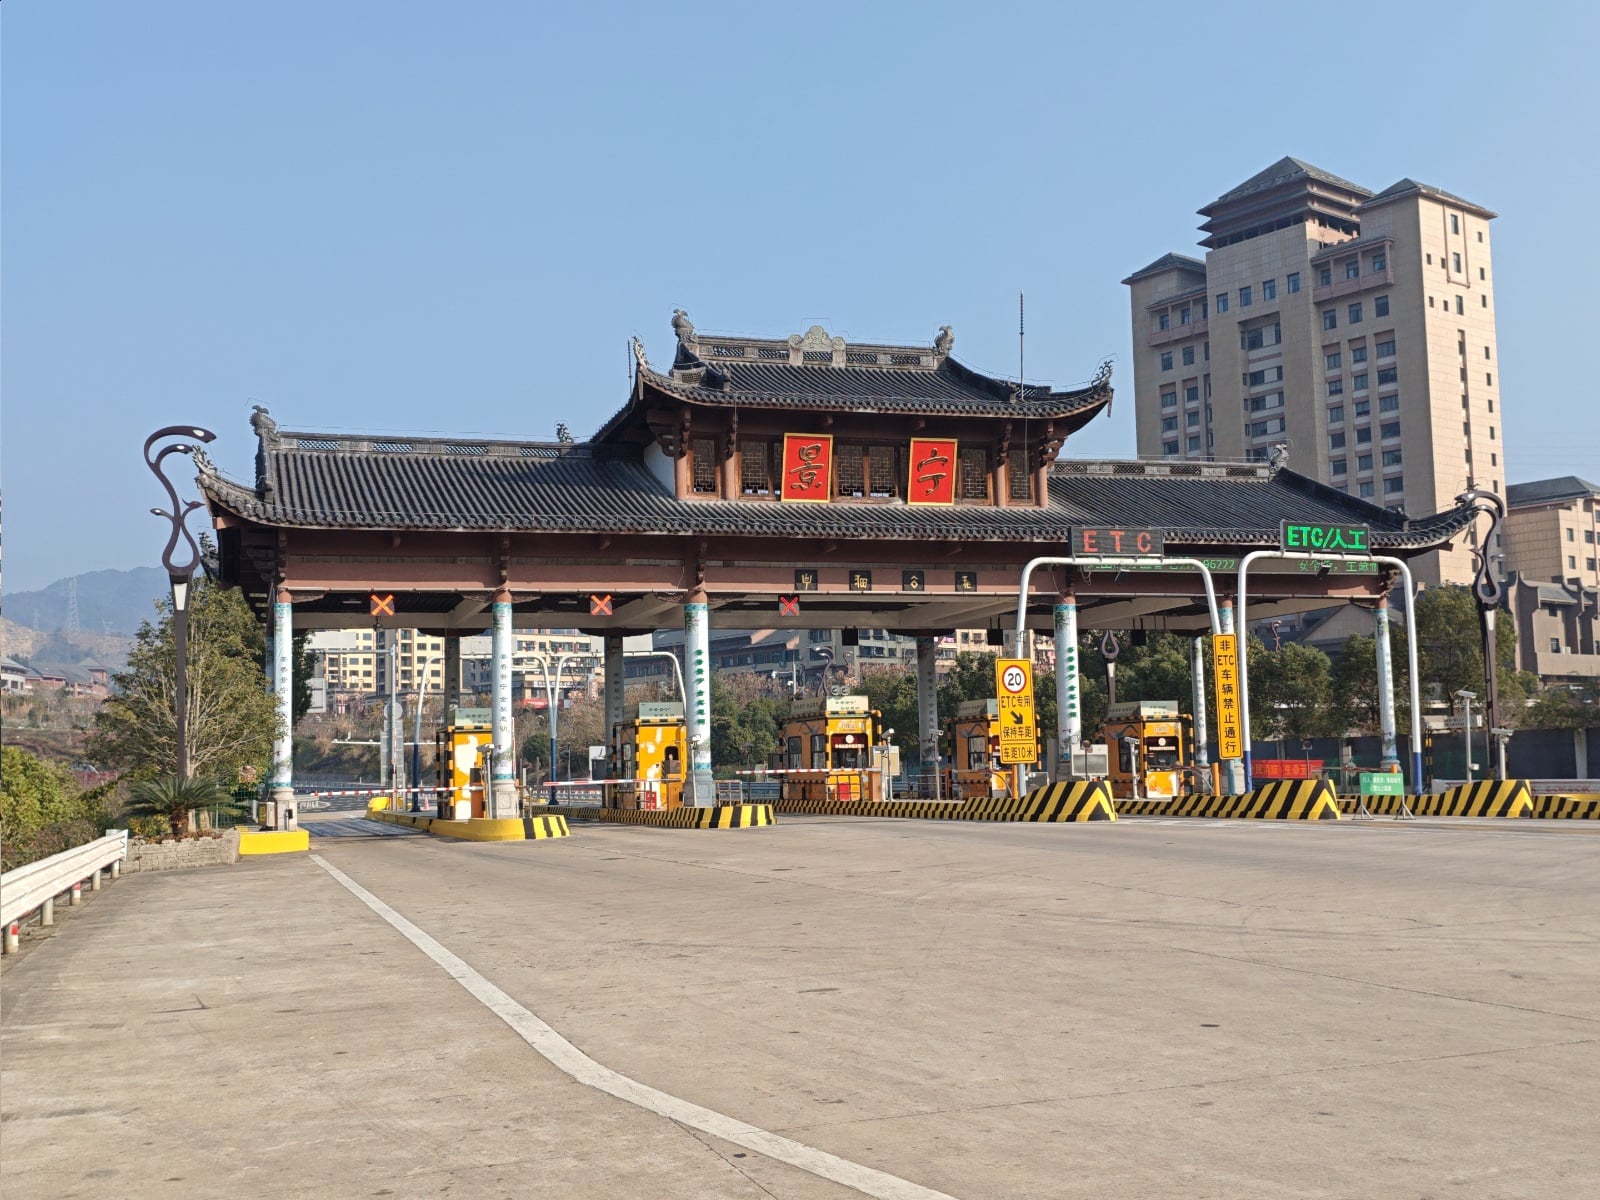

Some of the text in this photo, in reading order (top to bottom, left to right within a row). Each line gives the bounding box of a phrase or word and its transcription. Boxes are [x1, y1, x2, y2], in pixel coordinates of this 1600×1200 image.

[1083, 530, 1152, 553] ETC
[1287, 525, 1367, 549] ETC/人工
[1007, 672, 1022, 687] 20
[1001, 695, 1031, 709] ETC专用
[1217, 639, 1238, 754] 非ETC车辆禁止通行
[1003, 726, 1032, 739] 保持车距
[1003, 746, 1034, 760] 车距10米
